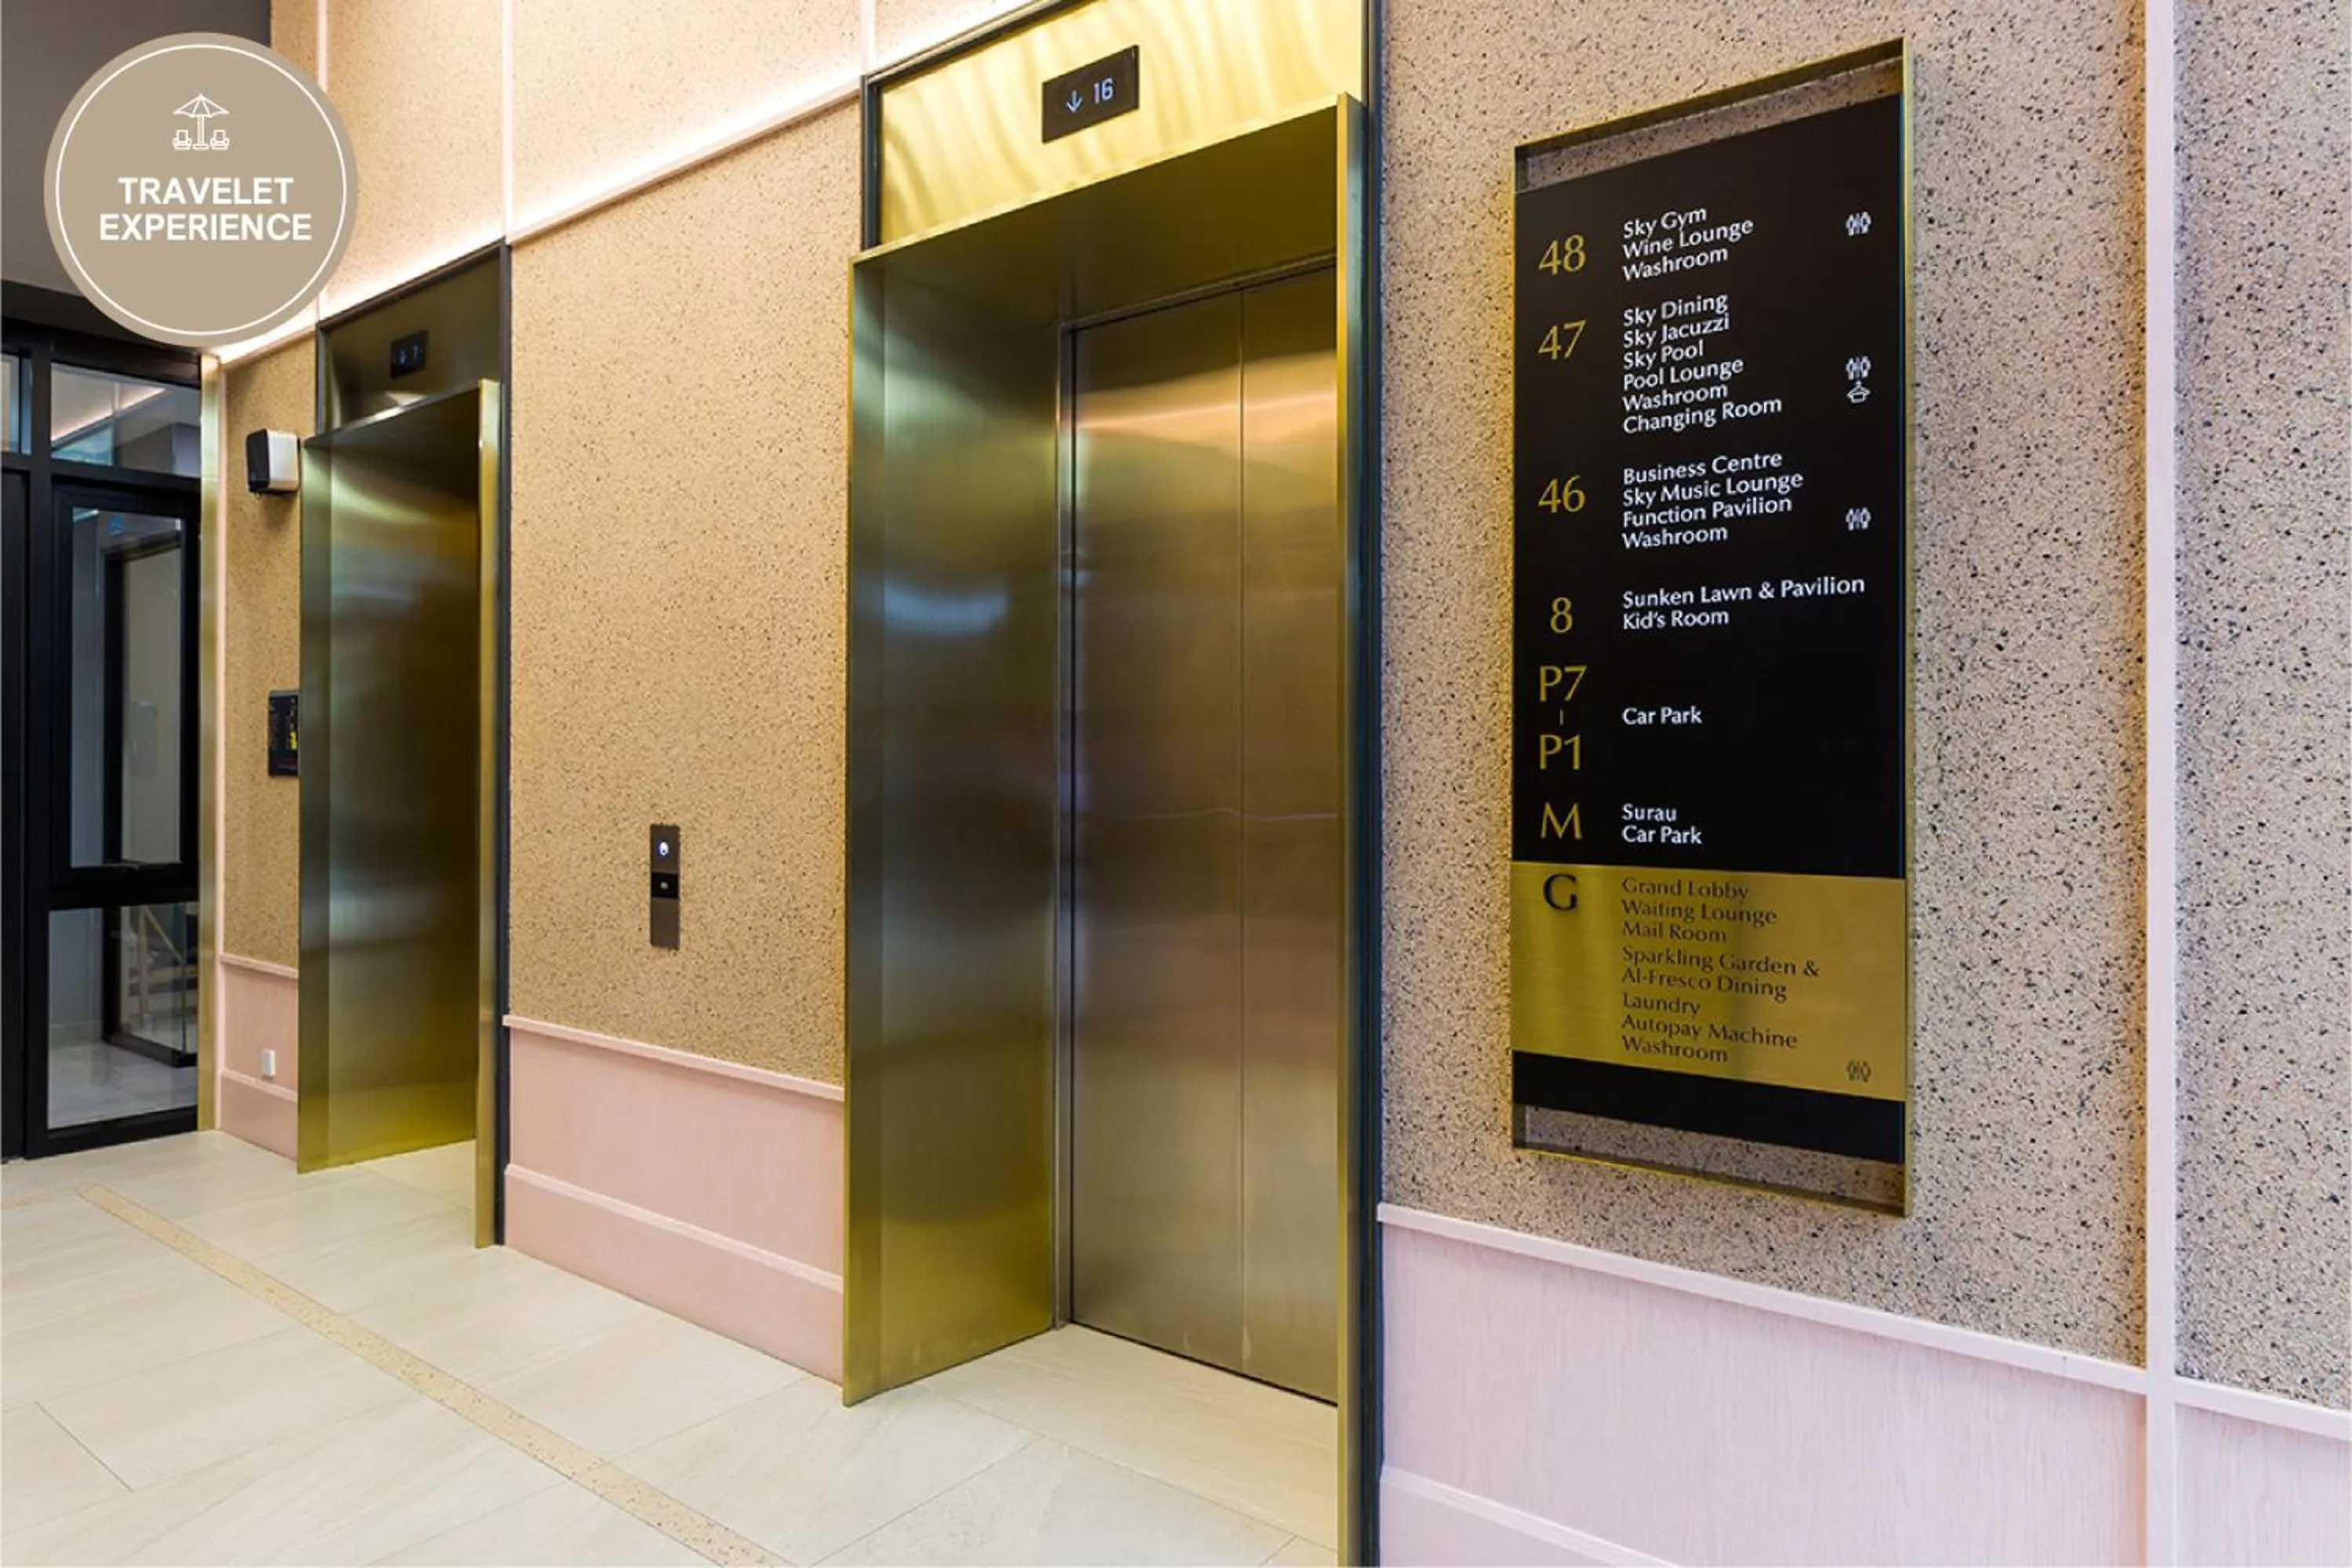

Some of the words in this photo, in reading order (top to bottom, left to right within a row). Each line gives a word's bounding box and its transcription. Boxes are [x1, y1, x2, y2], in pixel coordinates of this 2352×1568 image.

[1094, 78, 1113, 104] 16
[1622, 237, 1673, 259] Wine
[1679, 219, 1754, 248] Lounge
[1623, 220, 1657, 238] Sky
[1661, 208, 1707, 231] Gym
[1538, 234, 1586, 275] 48
[1622, 247, 1728, 281] Washroom
[1623, 307, 1656, 327] Sky
[1661, 295, 1728, 320] Dining
[1538, 320, 1586, 361] 47
[1623, 329, 1656, 348] Sky
[1661, 314, 1730, 344] Jacuzzi
[1623, 351, 1656, 369] Sky
[1661, 341, 1703, 364] Pool
[1624, 372, 1664, 390] Pool
[1670, 358, 1744, 383] Lounge
[1622, 383, 1728, 412] Washroom
[1623, 408, 1716, 434] Changing
[1722, 398, 1782, 419] Room
[1624, 461, 1706, 485] Business
[1711, 452, 1782, 474] Centre
[1538, 475, 1586, 514] 46
[1623, 488, 1656, 507] Sky
[1661, 482, 1721, 503] Music
[1727, 473, 1803, 495] Lounge
[1624, 506, 1706, 527] Function
[1712, 496, 1792, 519] Pavilion
[1622, 527, 1728, 549] Washroom
[1622, 589, 1694, 609] Sunken
[1701, 585, 1753, 603] Lawn
[1759, 582, 1775, 599] &
[1780, 576, 1865, 597] Pavilion
[1550, 597, 1573, 634] 8
[1623, 612, 1666, 630] Kid's
[1671, 609, 1730, 626] Room
[1539, 665, 1587, 702] P7
[1623, 708, 1656, 725] Car
[1661, 706, 1702, 724] Park
[1539, 734, 1581, 770] P1
[1541, 802, 1582, 840] M
[1622, 804, 1677, 822] Surau
[1622, 826, 1656, 844] Car
[1661, 826, 1702, 844] Park
[1543, 874, 1579, 911] G
[1622, 877, 1682, 895] Grand
[1622, 900, 1695, 922] Waiting
[1701, 906, 1777, 925] Lounge
[1623, 921, 1664, 940] Mail
[1669, 925, 1726, 942] Room
[1622, 947, 1714, 972] Sparkling
[1720, 954, 1797, 975] Garden
[1803, 960, 1820, 977] &
[1621, 967, 1712, 991] Al-Fresco
[1718, 976, 1787, 1000] Dining
[1623, 993, 1701, 1017] Laundry
[1621, 1014, 1702, 1041] Autopay
[1708, 1024, 1798, 1048] Machine
[1621, 1036, 1729, 1063] Washroom
